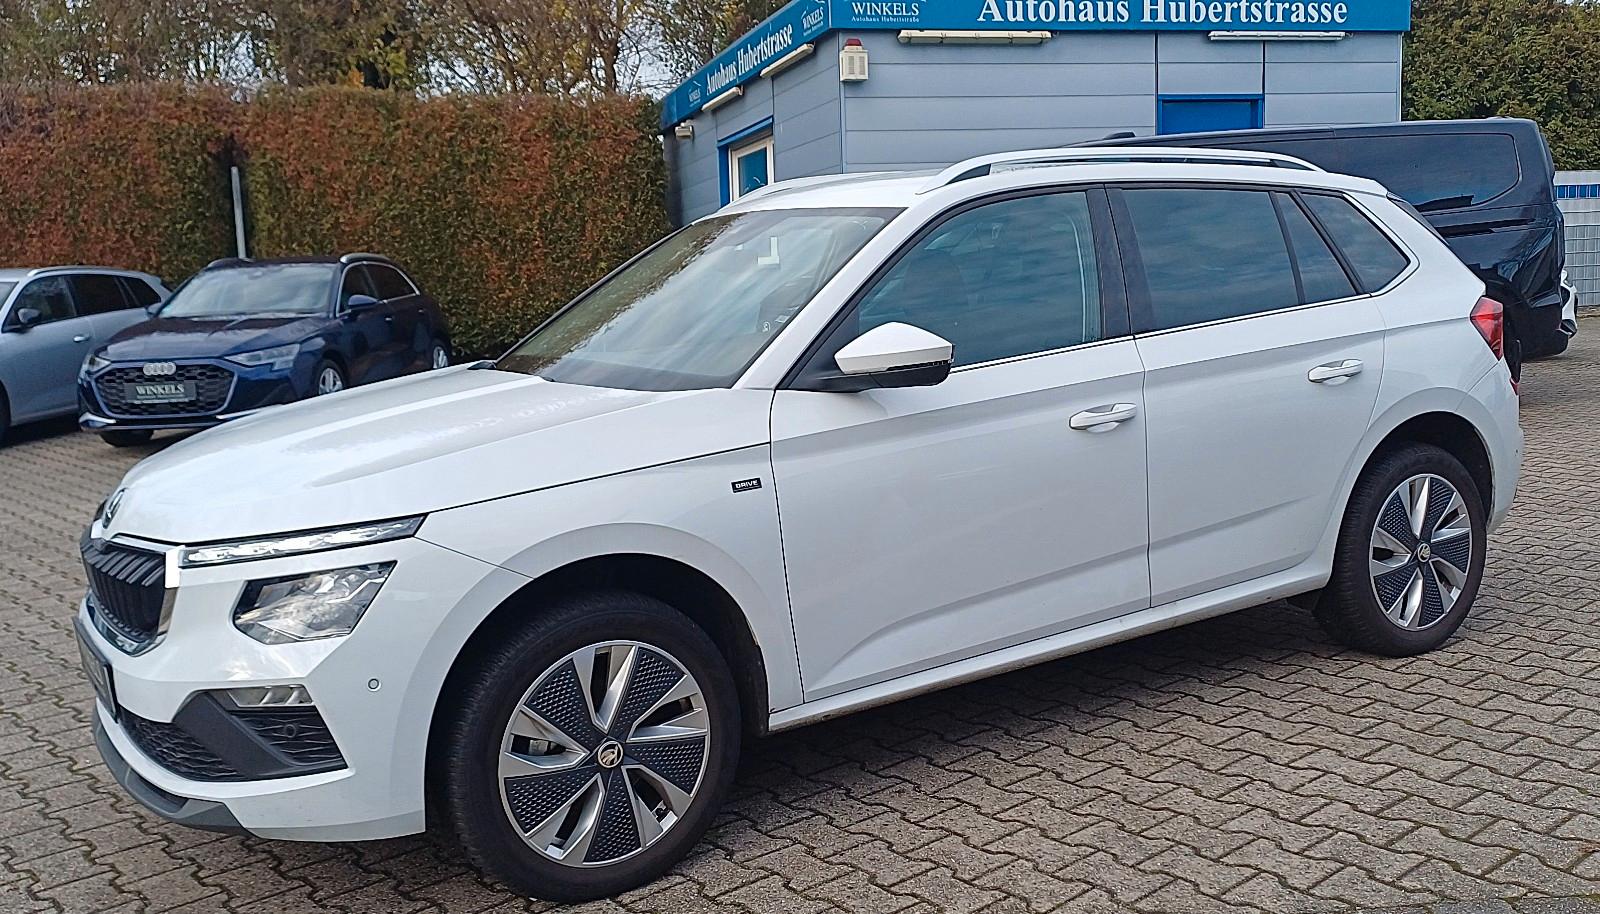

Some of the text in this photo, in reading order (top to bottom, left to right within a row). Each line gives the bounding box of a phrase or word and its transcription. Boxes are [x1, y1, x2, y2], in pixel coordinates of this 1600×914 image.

[851, 2, 919, 16] WINKELS
[977, 0, 1348, 23] Autohaus Hubertstrasse
[706, 23, 793, 96] Autohaus Hubertstrasse
[136, 384, 184, 395] WINKELS
[735, 480, 758, 488] DRIVE
